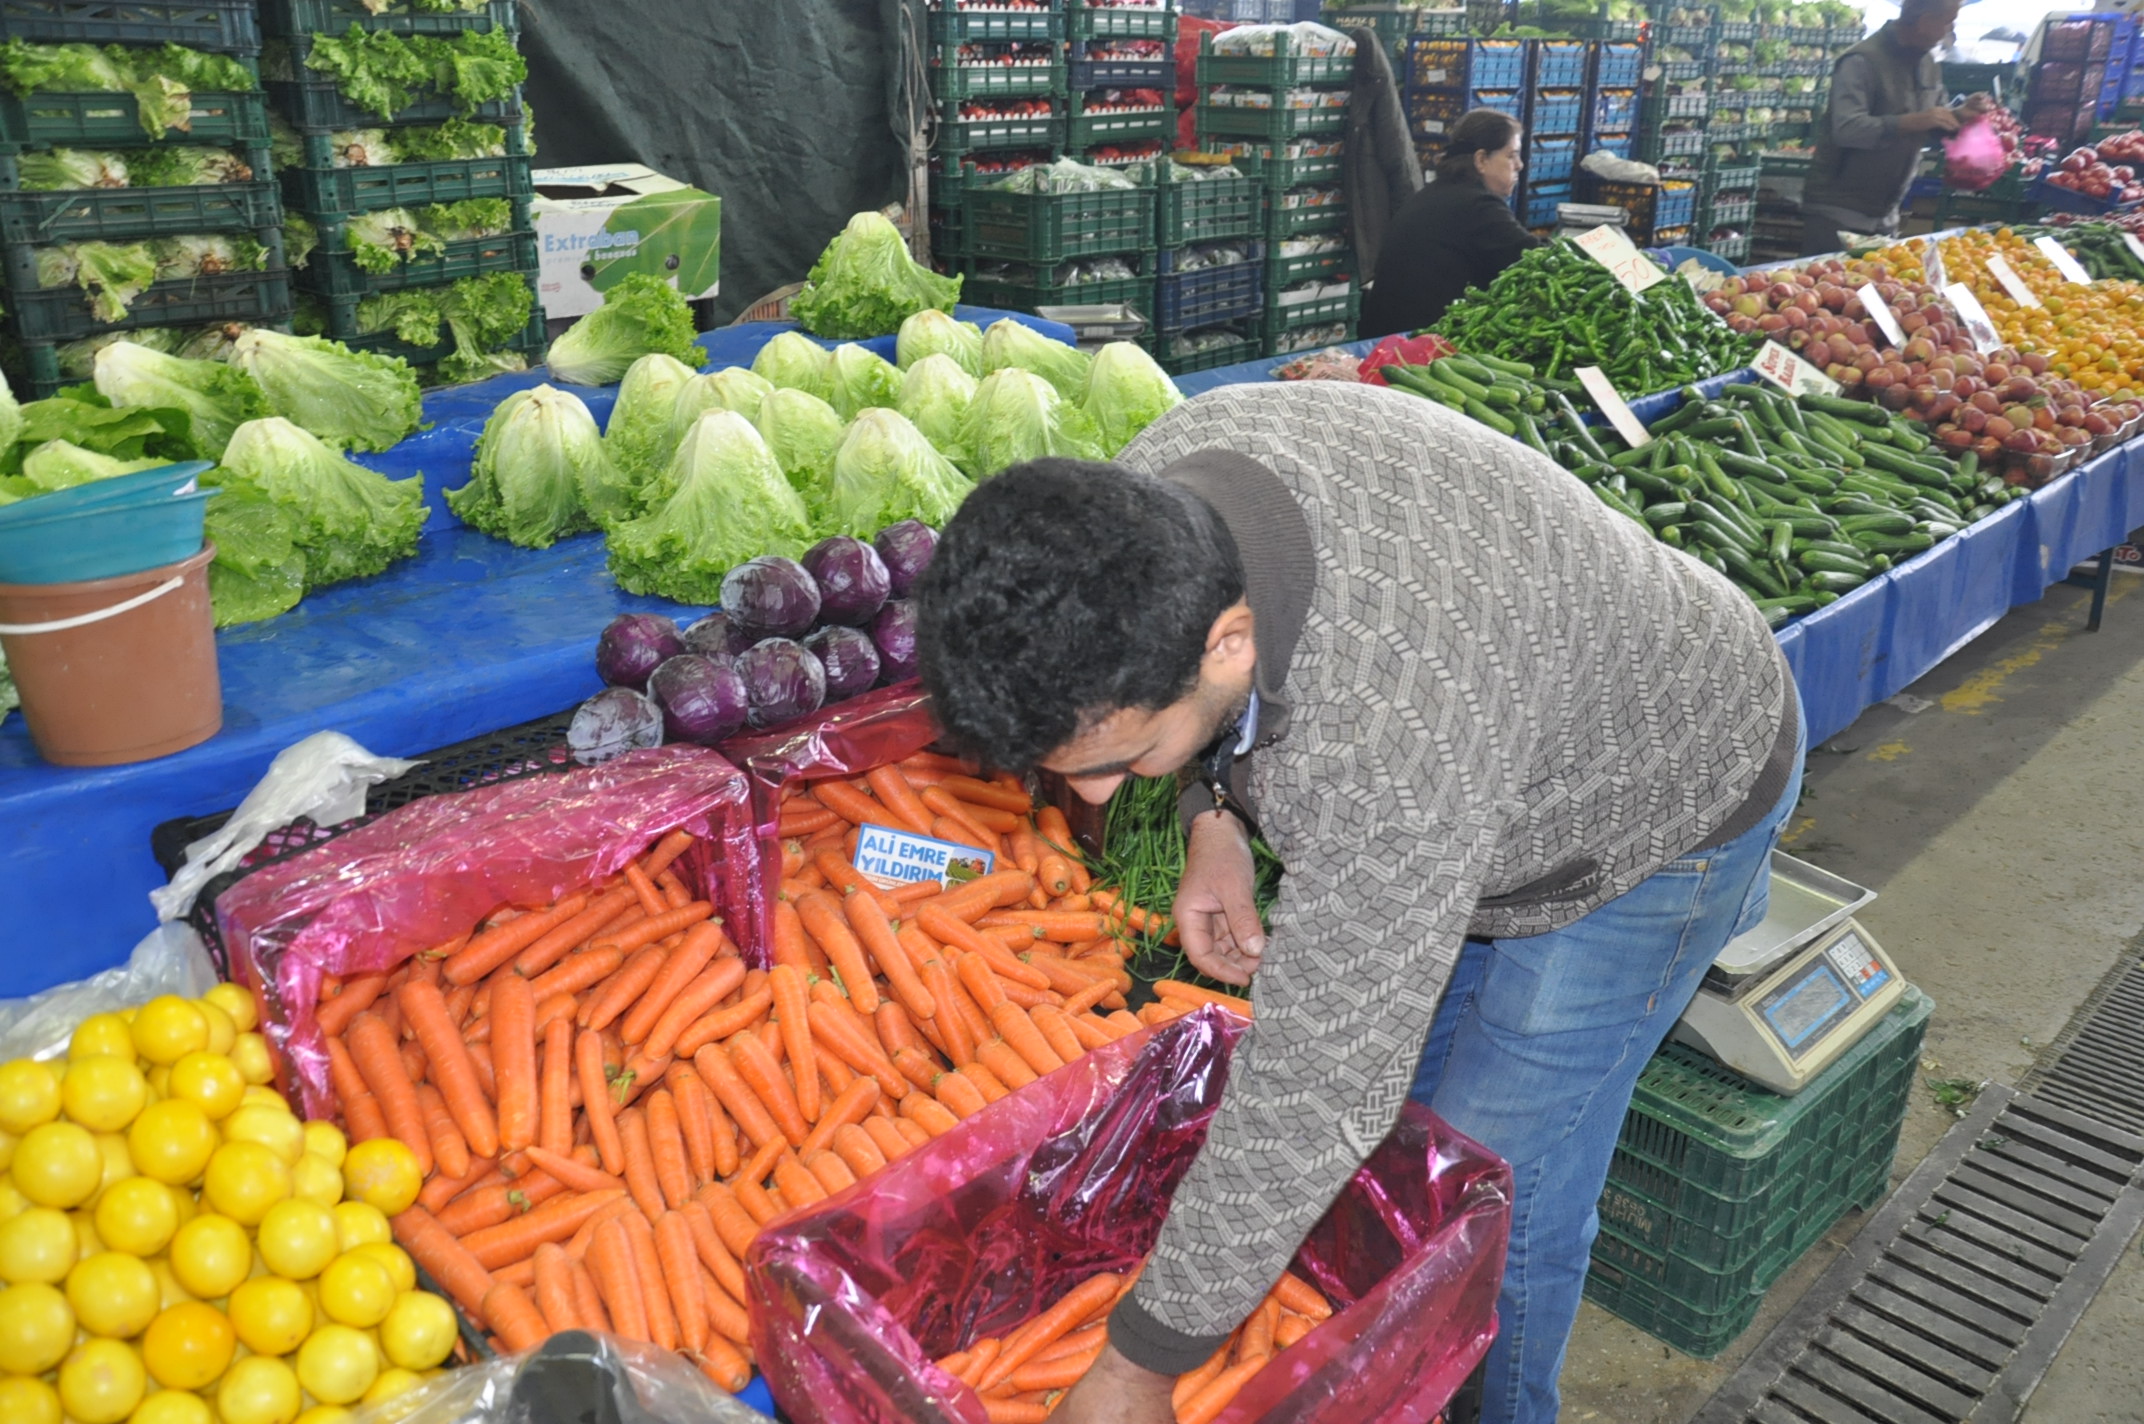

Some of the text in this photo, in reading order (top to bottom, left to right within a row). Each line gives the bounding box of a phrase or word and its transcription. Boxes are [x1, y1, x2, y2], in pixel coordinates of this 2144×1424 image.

[544, 226, 640, 252] Extraban
[864, 835, 947, 867] ALİ EMRE
[861, 855, 943, 882] YILDIRIM
